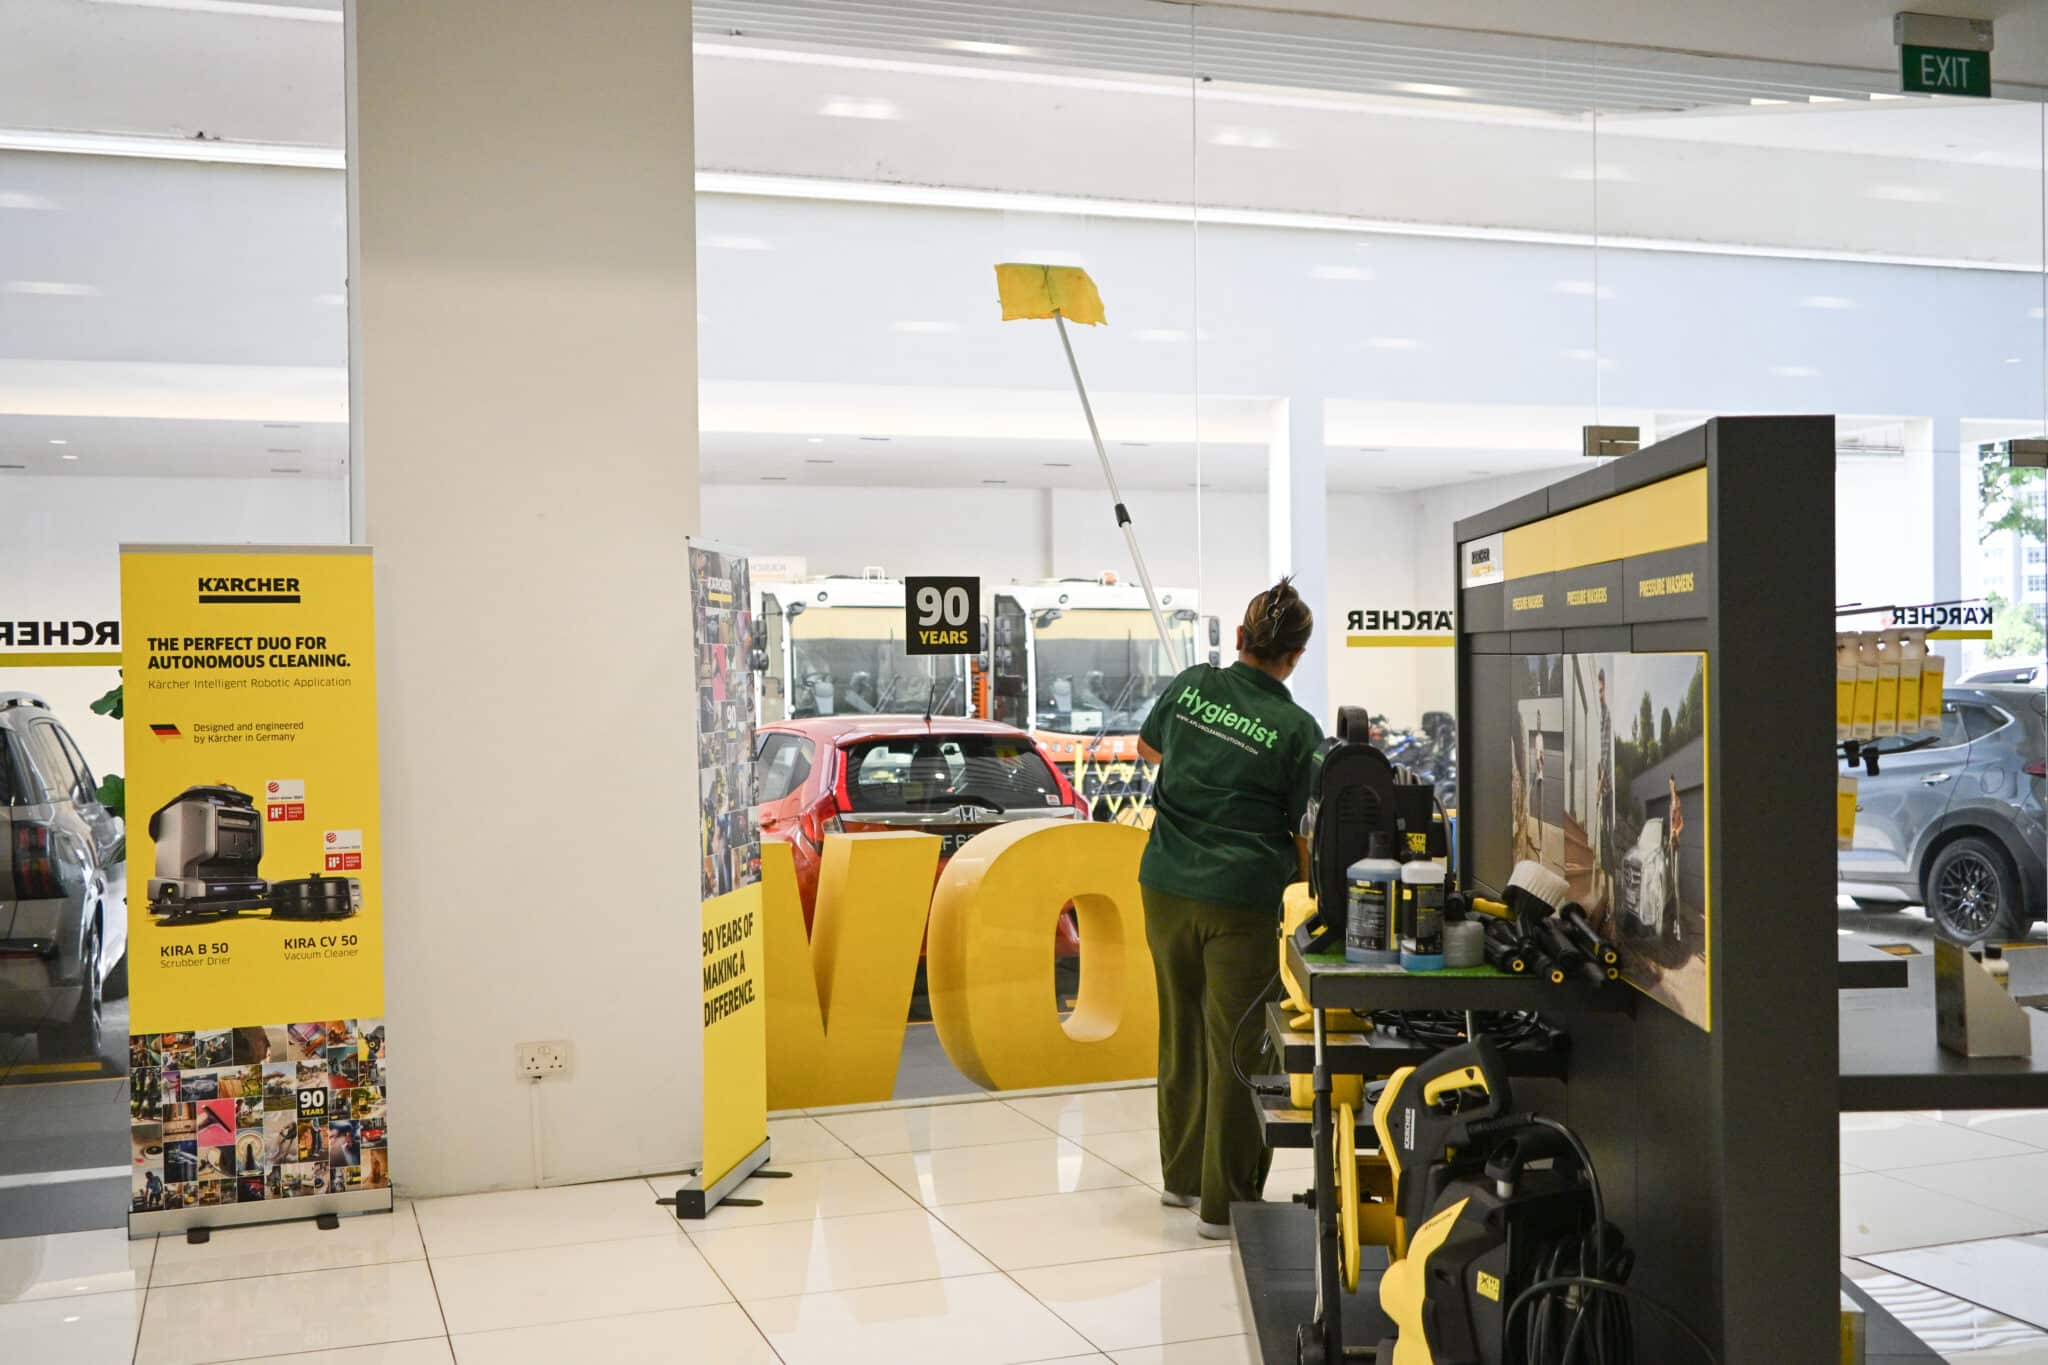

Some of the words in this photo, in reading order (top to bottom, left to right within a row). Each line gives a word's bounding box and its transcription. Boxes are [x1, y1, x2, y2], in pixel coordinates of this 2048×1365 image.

[1921, 54, 1970, 88] EXIT
[198, 577, 300, 592] KÄRCHER
[1639, 576, 1665, 598] PRESSURE
[1665, 572, 1694, 594] WASHERS
[1567, 589, 1586, 606] PRESSURE
[916, 586, 970, 626] 90
[147, 637, 179, 651] THE
[183, 636, 252, 651] PERFECT
[257, 636, 291, 650] DUO
[295, 636, 327, 650] FOR
[919, 630, 968, 645] YEARS
[147, 654, 265, 669] AUTONOMOUS
[269, 653, 351, 668] CLEANING.
[148, 679, 190, 689] Kärcher
[194, 678, 248, 690] Intelligent
[250, 678, 290, 688] Robotic
[293, 677, 351, 689] Application
[1177, 685, 1278, 749] Hygienist
[193, 723, 234, 733] Designed
[237, 722, 253, 731] and
[255, 721, 304, 732] engineered
[193, 735, 205, 744] by
[208, 734, 241, 743] Kärcher
[245, 733, 253, 742] in
[255, 732, 295, 743] Germany
[284, 937, 316, 949] KIRA
[320, 936, 337, 947] CV
[341, 934, 358, 946] 50
[702, 929, 714, 957] 90
[715, 916, 742, 951] YEARS
[743, 912, 753, 938] OF
[160, 945, 194, 957] KIRA
[198, 943, 207, 955] B
[211, 942, 229, 954] 50
[284, 951, 321, 961] Vacuum
[324, 948, 359, 958] Cleaner
[160, 957, 204, 968] Scrubber
[207, 956, 231, 966] Drier
[703, 952, 738, 993] MAKING
[739, 949, 746, 975] A
[704, 978, 756, 1028] DIFFERENCE.
[300, 1090, 324, 1108] 90
[302, 1107, 325, 1116] YEARS
